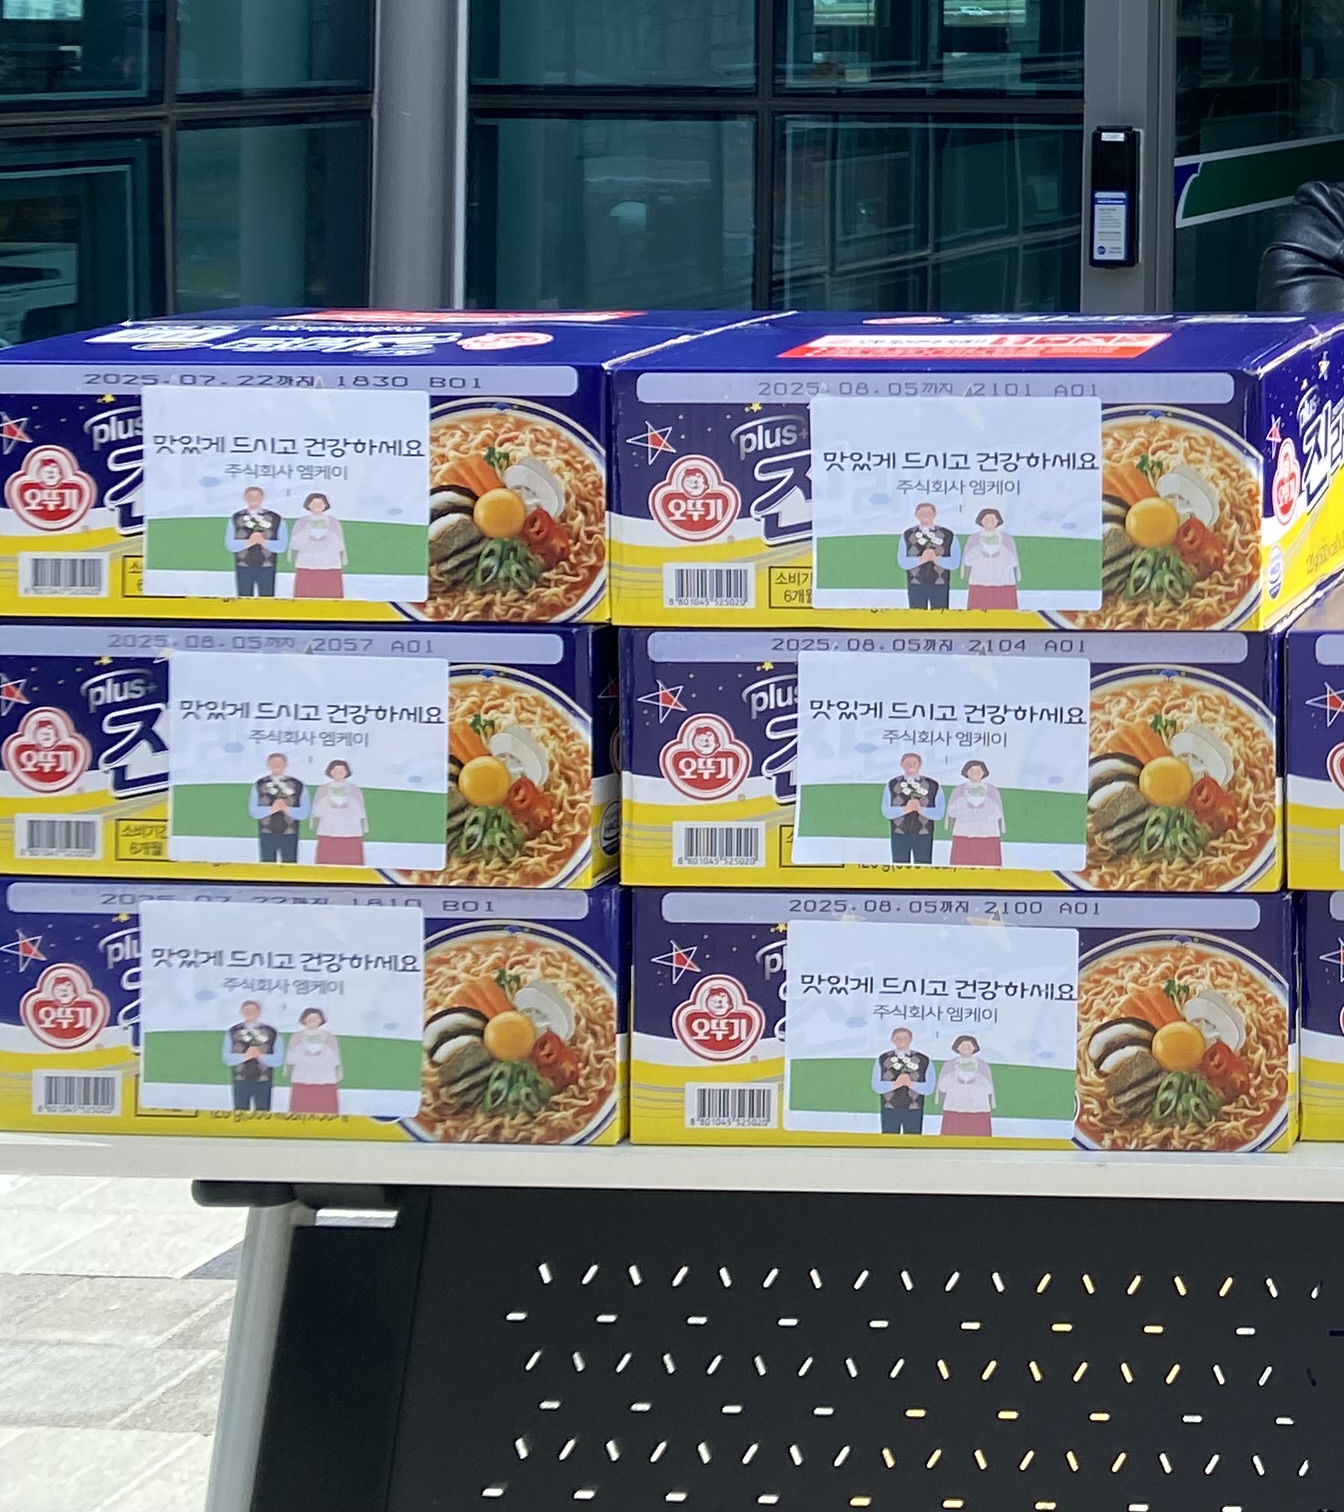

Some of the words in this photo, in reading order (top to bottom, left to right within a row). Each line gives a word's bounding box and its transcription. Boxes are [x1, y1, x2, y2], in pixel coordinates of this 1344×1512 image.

[335, 374, 409, 389] 1830
[429, 375, 482, 389] B01
[973, 381, 1033, 397] 2101
[1053, 382, 1099, 397] A01
[152, 433, 226, 457] 맛있게
[231, 436, 298, 457] 드시고
[303, 436, 426, 459] 건강하세요
[224, 463, 293, 481] 주식회사
[296, 464, 348, 481] 엠케이
[822, 449, 898, 474] 맛있게
[901, 450, 971, 474] 드시고
[976, 450, 1101, 474] 건강하세요
[896, 478, 966, 497] 주식회사
[968, 478, 1022, 497] 엠케이
[22, 485, 80, 513] 오뚜기
[666, 496, 724, 524] 오뚜기
[311, 637, 373, 653] 2057
[391, 639, 433, 654] A01
[967, 637, 1027, 654] 2104
[1043, 638, 1086, 654] A01
[180, 700, 250, 721] 맛있게
[254, 702, 322, 724] 드시고
[326, 704, 446, 726] 건강하세요
[809, 699, 884, 724] 맛있게
[888, 701, 958, 724] 드시고
[963, 703, 1087, 727] 건강하세요
[247, 728, 316, 747] 주식회사
[319, 730, 370, 748] 엠케이
[882, 730, 952, 747] 주식회사
[955, 730, 1008, 749] 엠케이
[19, 751, 75, 773] 오뚜기
[677, 756, 734, 780] 오뚜기
[442, 900, 496, 914] B01
[789, 899, 970, 915] 2025.08.05까지
[984, 900, 1043, 916] 2100
[1058, 901, 1100, 917] A01
[150, 947, 224, 970] 맛있게
[229, 948, 295, 971] 드시고
[299, 951, 420, 974] 건강하세요
[222, 976, 291, 994] 주식회사
[292, 978, 346, 996] 엠케이
[799, 973, 875, 998] 맛있게
[877, 975, 947, 999] 드시고
[953, 978, 1078, 1002] 건강하세요
[38, 1006, 94, 1031] 오뚜기
[871, 1002, 943, 1022] 주식회사
[945, 1005, 999, 1024] 엠케이
[690, 1018, 748, 1042] 오뚜기
